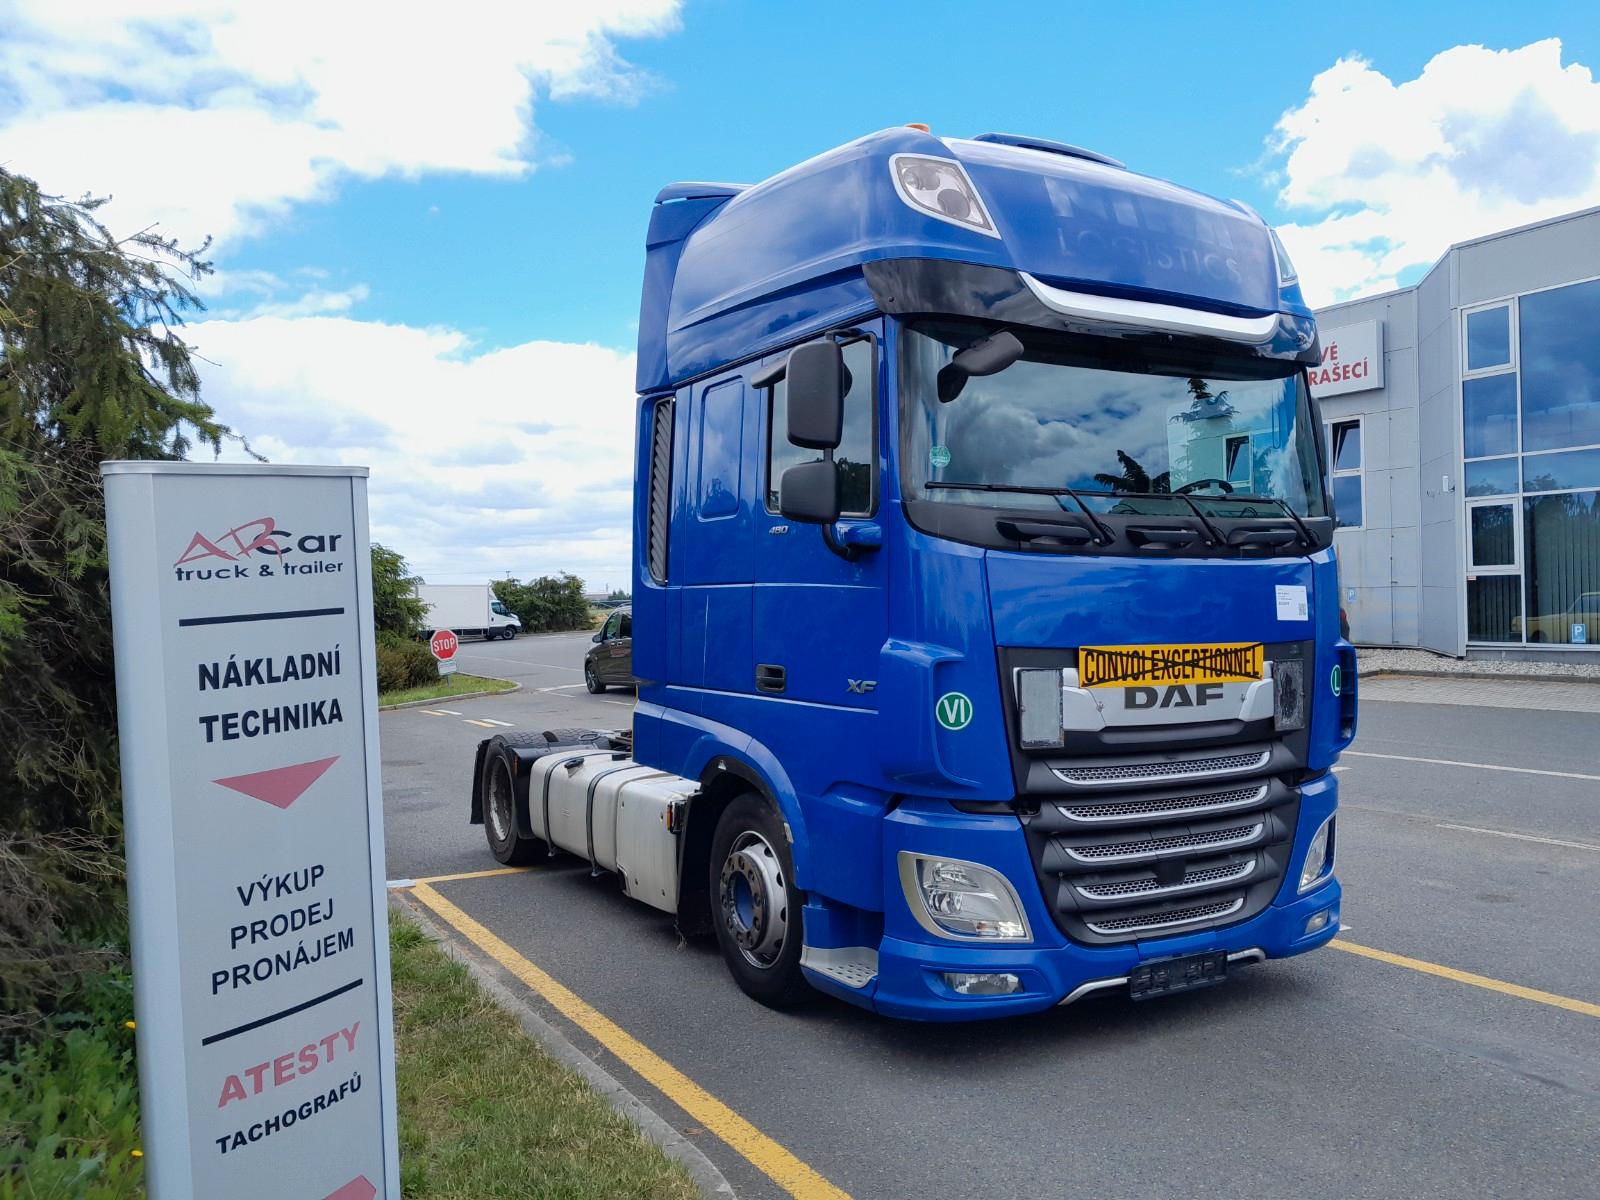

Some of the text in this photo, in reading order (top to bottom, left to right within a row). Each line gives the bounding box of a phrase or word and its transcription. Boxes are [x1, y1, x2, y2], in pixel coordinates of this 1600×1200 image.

[769, 525, 789, 534] 480
[175, 560, 343, 581] truck & trailer
[433, 637, 455, 652] STOP
[1084, 646, 1260, 683] CONVOI EXCEPTIONNEL
[198, 644, 341, 690] NÁKLADNÍ
[846, 678, 877, 693] XF
[943, 698, 965, 724] VI
[1124, 683, 1224, 710] DAF
[199, 698, 344, 743] TECHNIKA
[237, 864, 325, 907] VÝKUP
[230, 898, 334, 949] PRODEJ
[211, 927, 355, 995] PRONÁJEM
[218, 1020, 361, 1109] ATESTY
[215, 1071, 362, 1154] TACHOGRAFŮ
